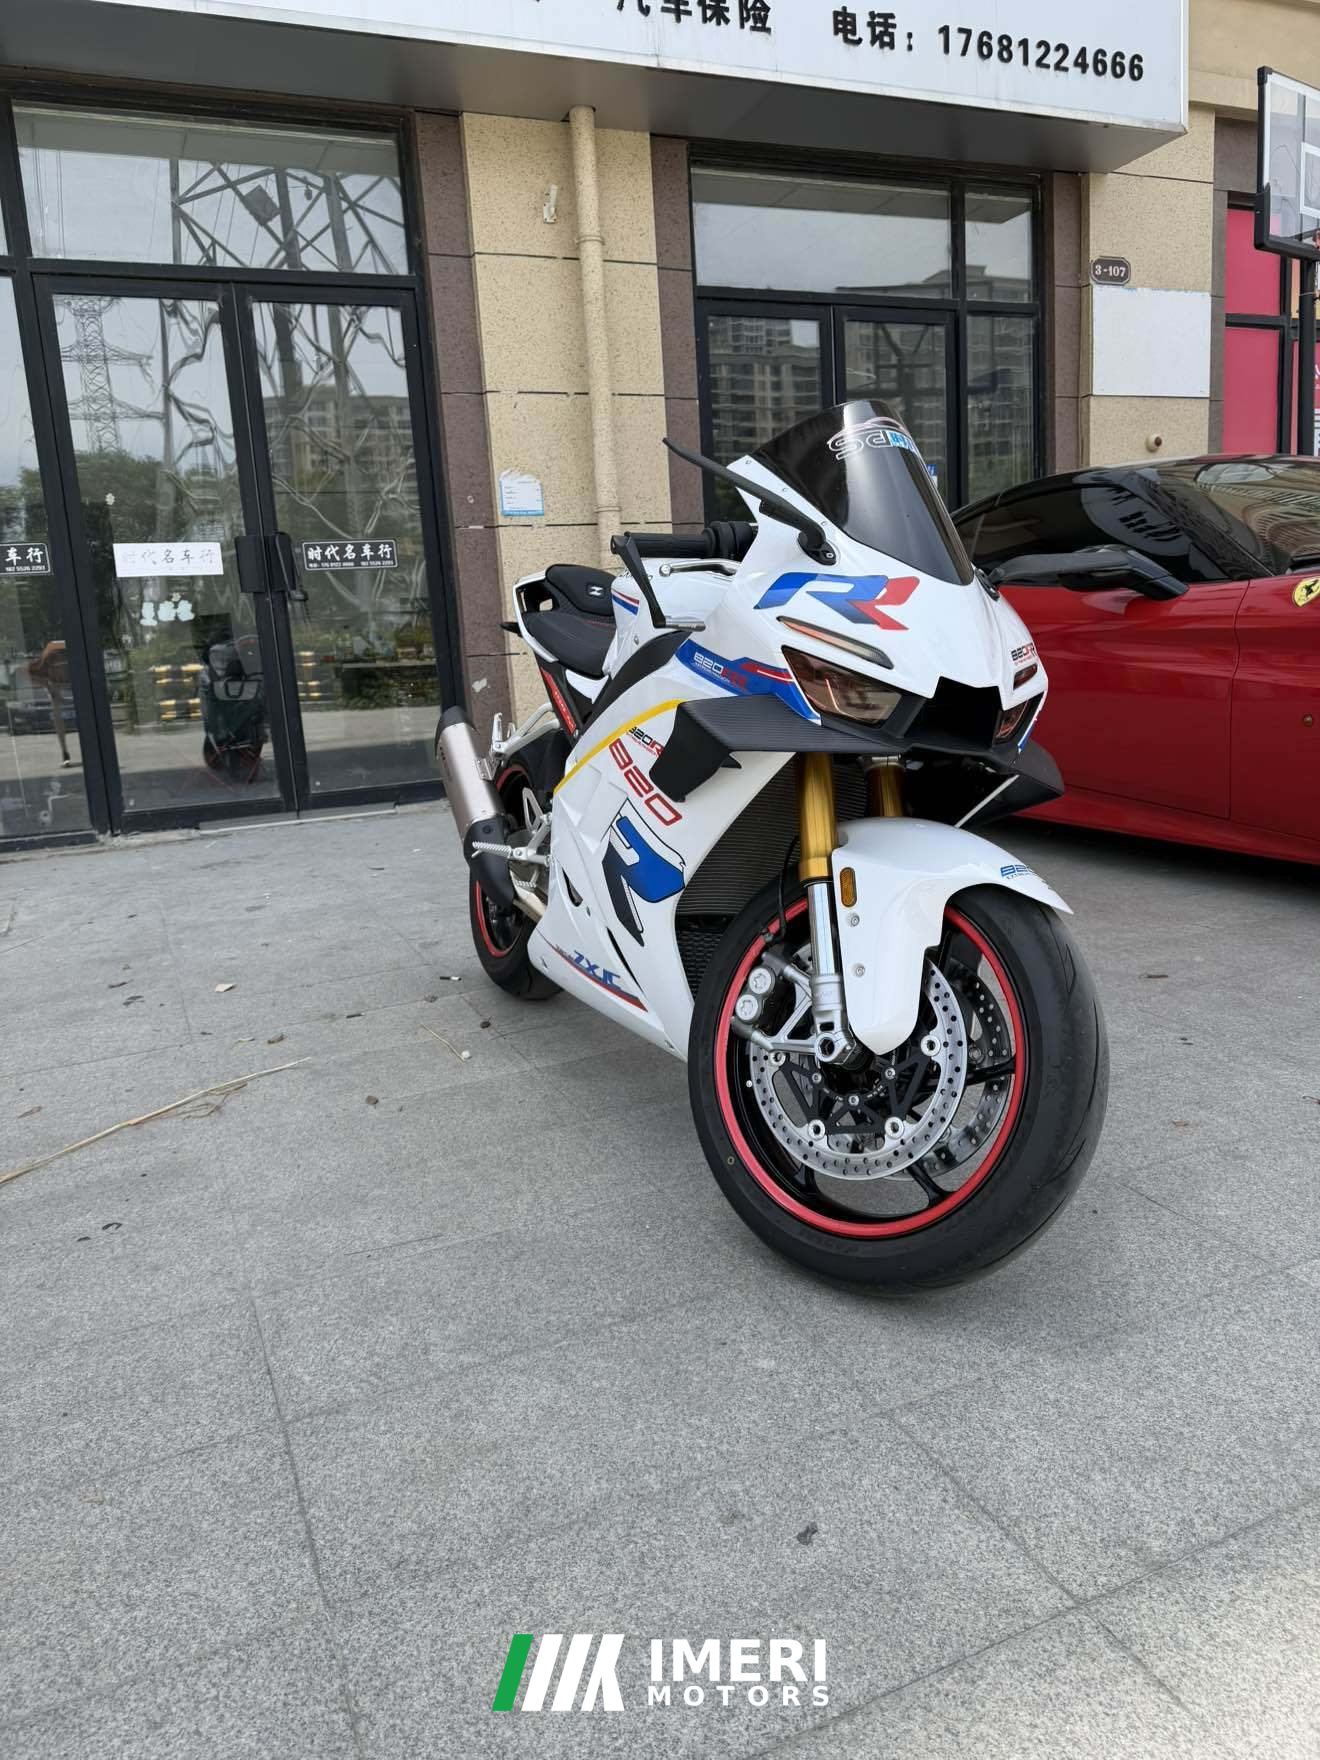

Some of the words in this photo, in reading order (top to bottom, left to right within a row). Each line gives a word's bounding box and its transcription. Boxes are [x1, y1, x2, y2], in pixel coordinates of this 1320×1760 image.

[938, 25, 1144, 81] 17681224666
[1095, 264, 1126, 277] 3-107
[5, 546, 44, 566] 车行
[307, 543, 393, 561] 时代名车行
[608, 738, 683, 826] 820
